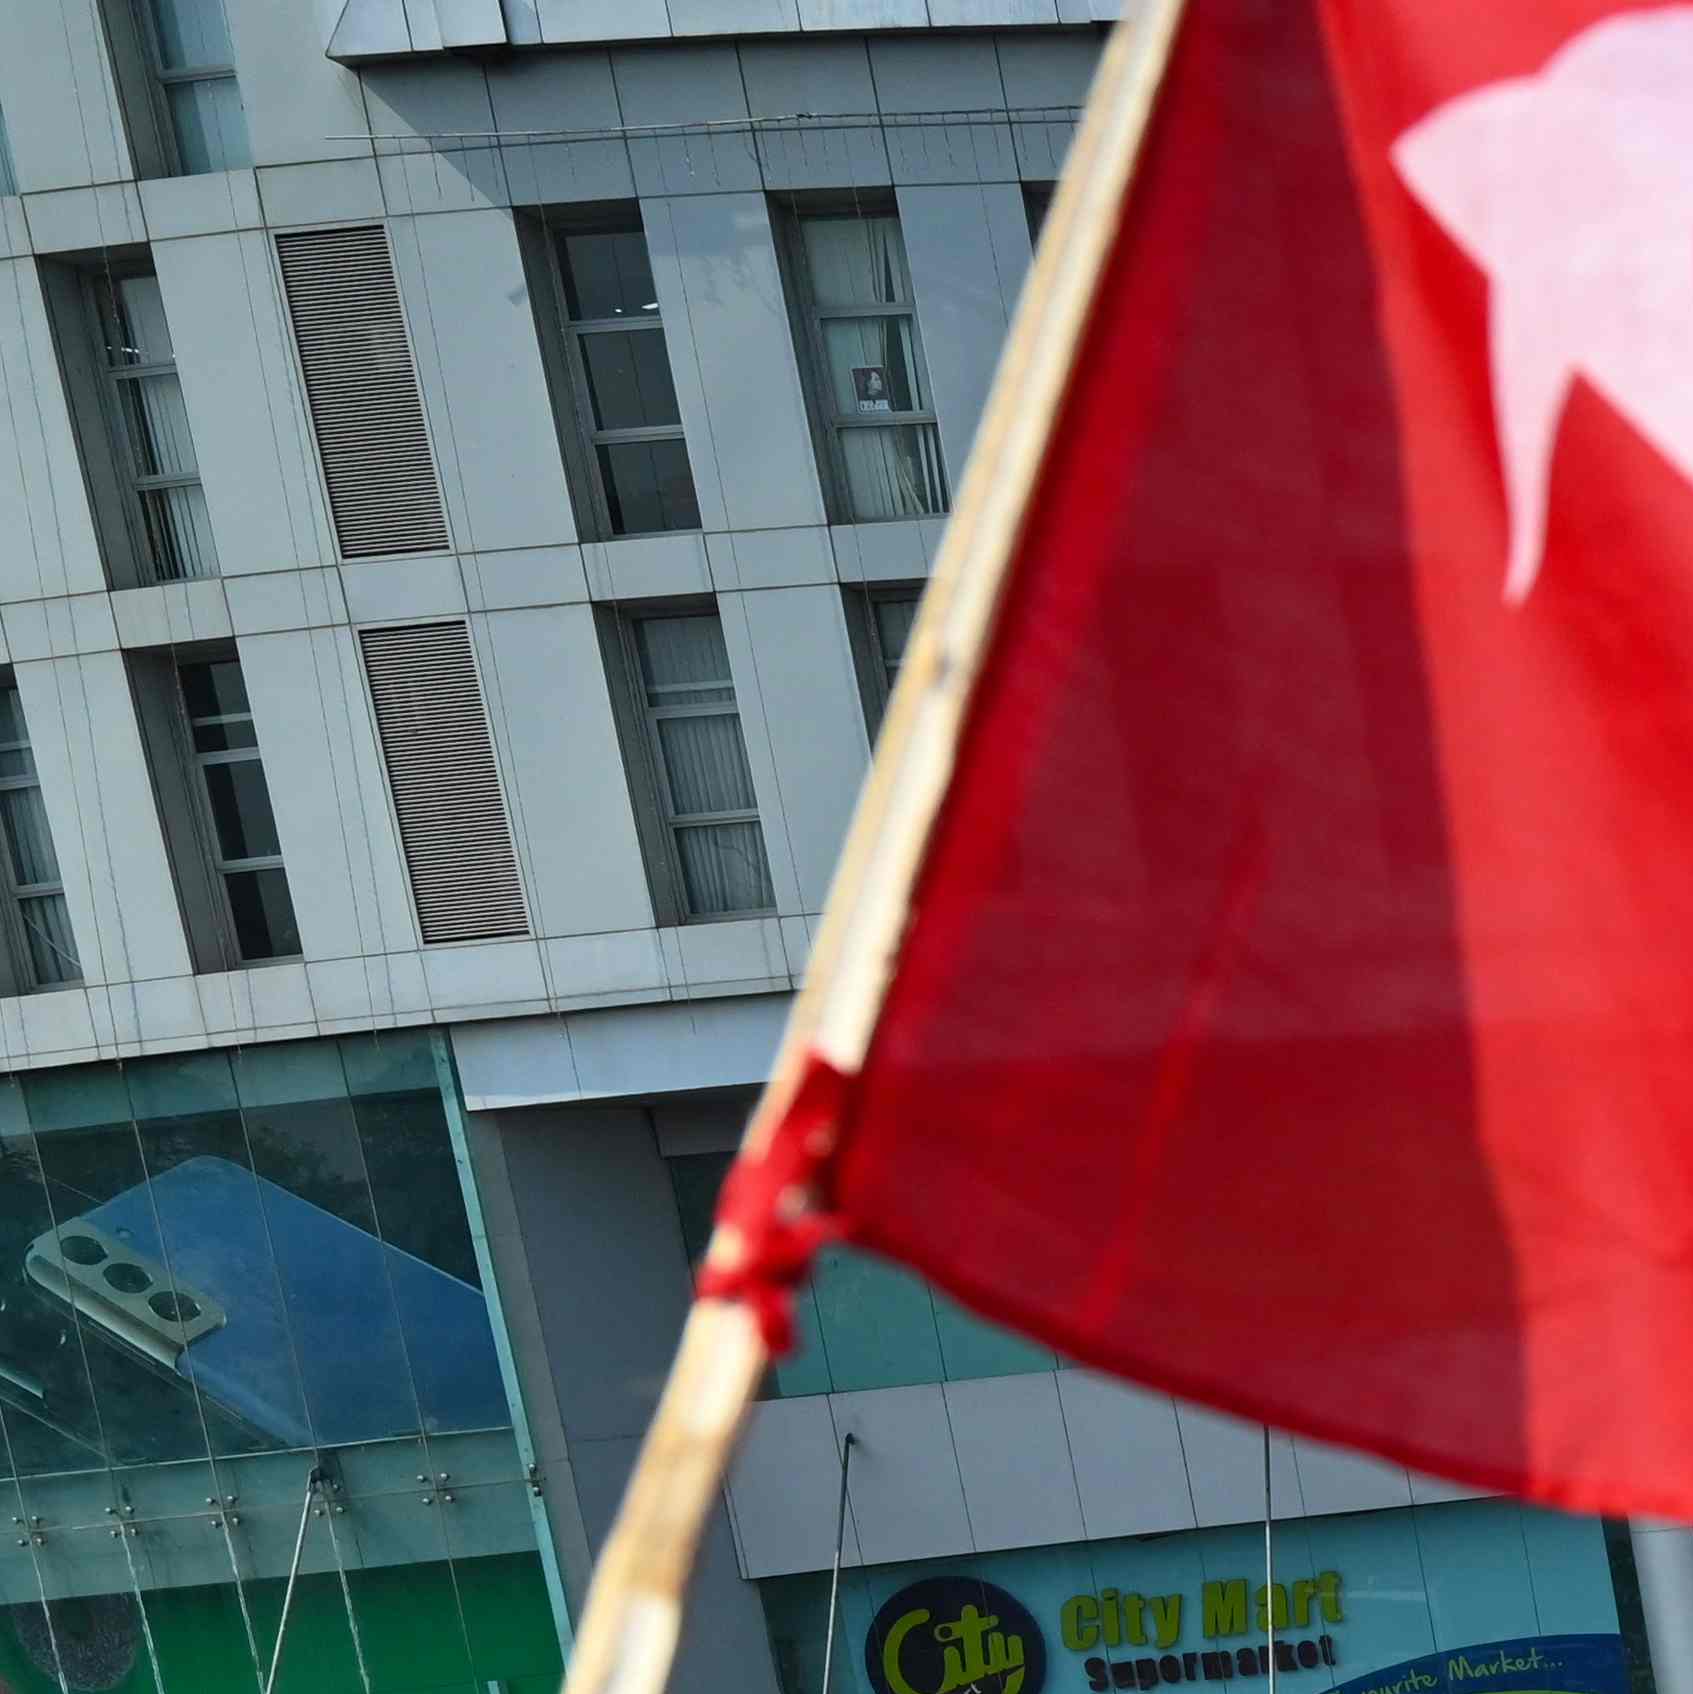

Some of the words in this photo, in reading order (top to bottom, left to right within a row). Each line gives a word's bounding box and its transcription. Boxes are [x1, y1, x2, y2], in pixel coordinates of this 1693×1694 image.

[1060, 1588, 1182, 1652] City
[1202, 1570, 1345, 1639] Mart
[1084, 1634, 1337, 1693] Supermarket
